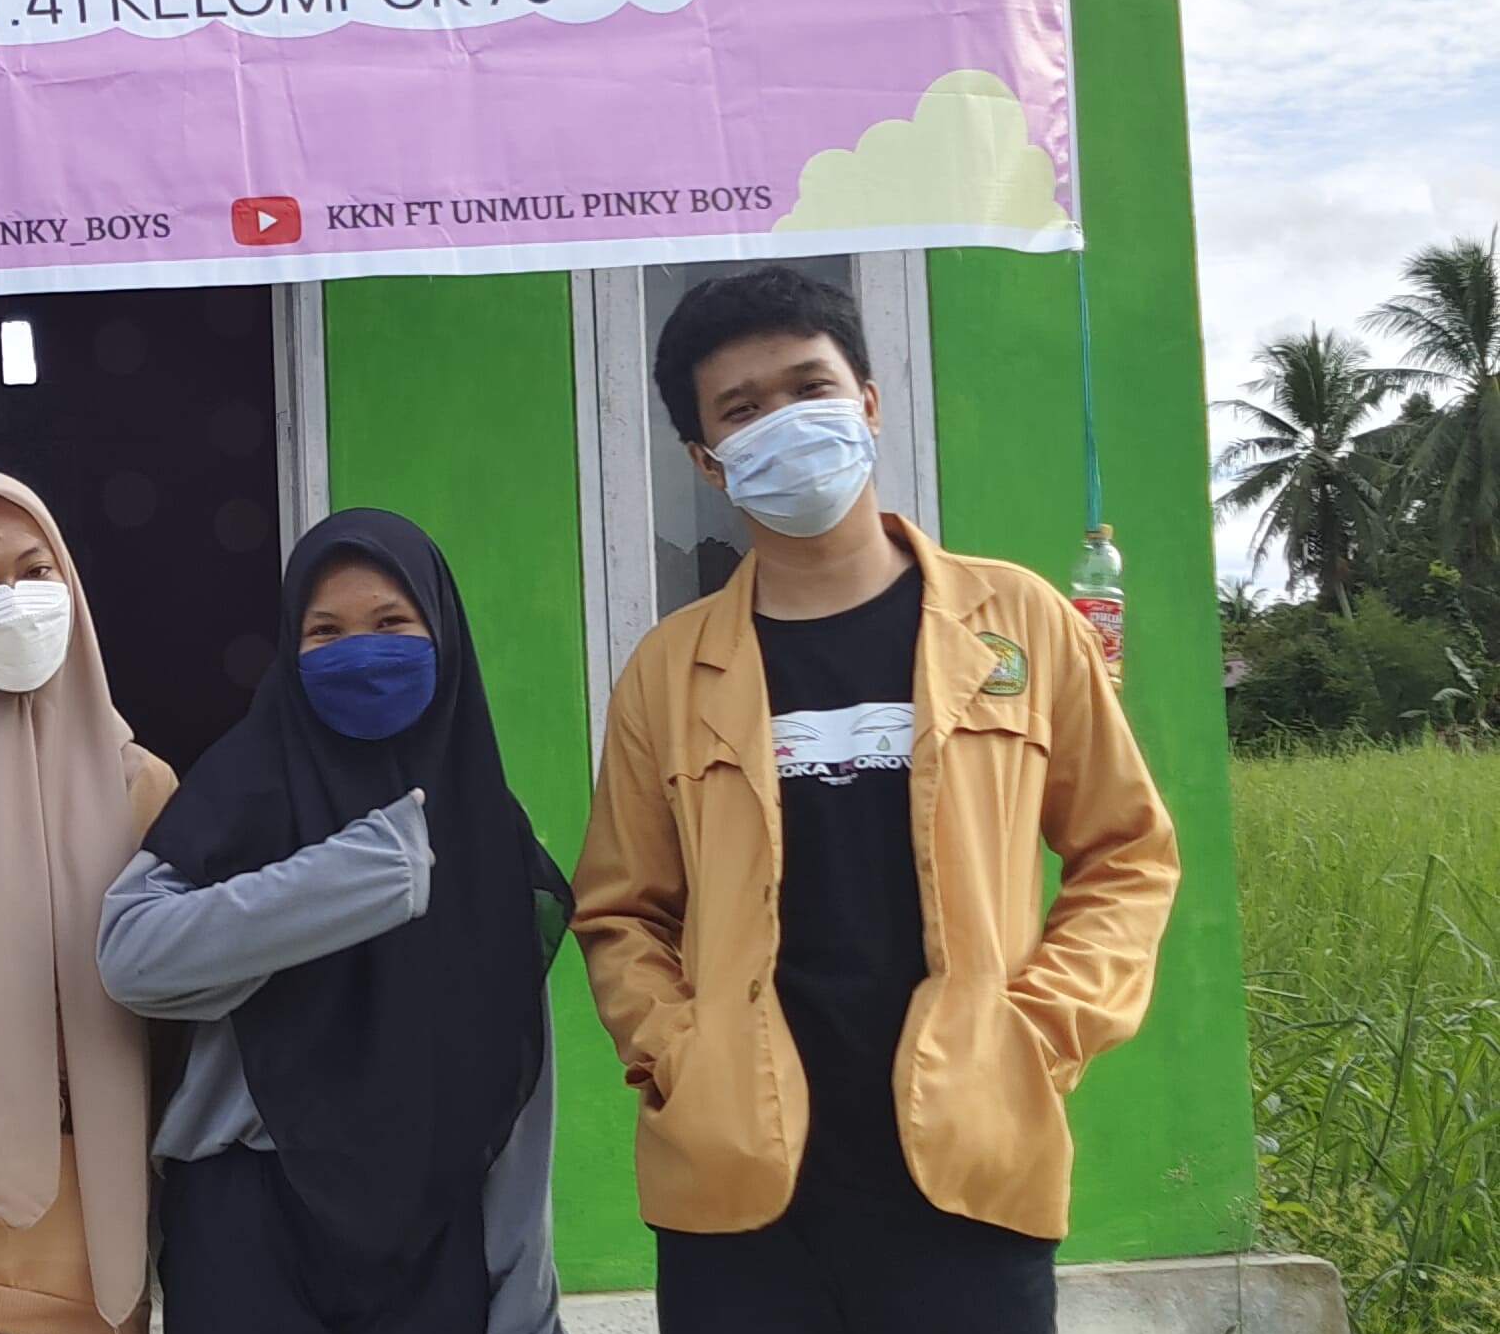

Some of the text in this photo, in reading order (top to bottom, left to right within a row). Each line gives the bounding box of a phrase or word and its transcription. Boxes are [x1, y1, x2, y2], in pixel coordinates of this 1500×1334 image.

[327, 185, 773, 231] KKN FT UNMUL PINKY BOYS
